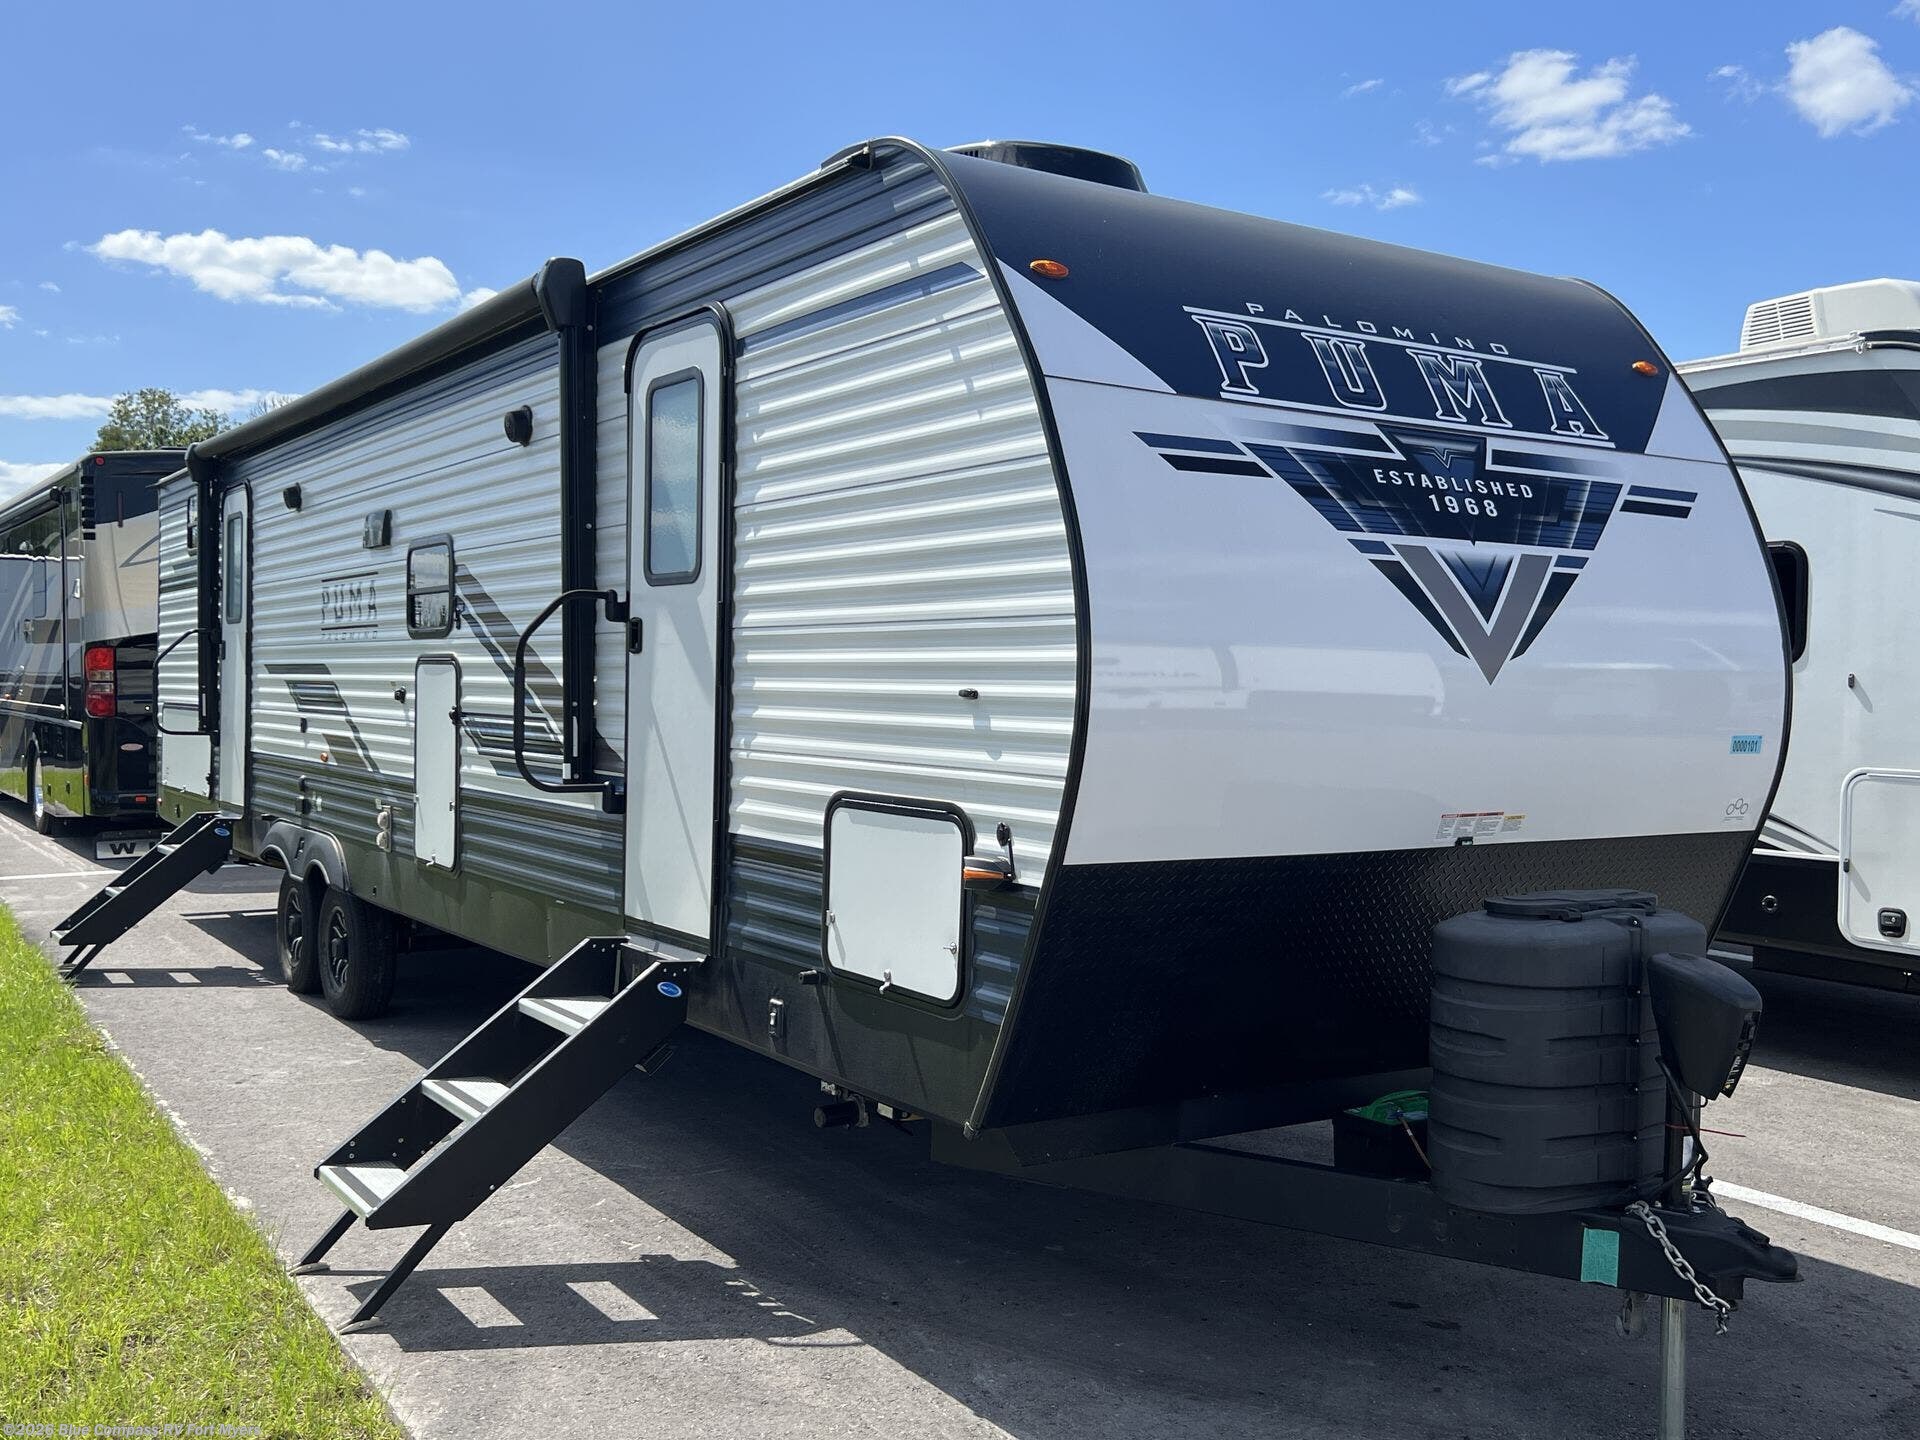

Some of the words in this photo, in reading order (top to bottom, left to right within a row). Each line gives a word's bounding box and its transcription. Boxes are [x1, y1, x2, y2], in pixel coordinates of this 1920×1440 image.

[1246, 302, 1508, 356] PALOMINO
[1191, 315, 1609, 440] PUMA
[1373, 468, 1533, 498] ESTABLISHED
[1428, 494, 1498, 517] 1968
[321, 580, 377, 623] PUMA
